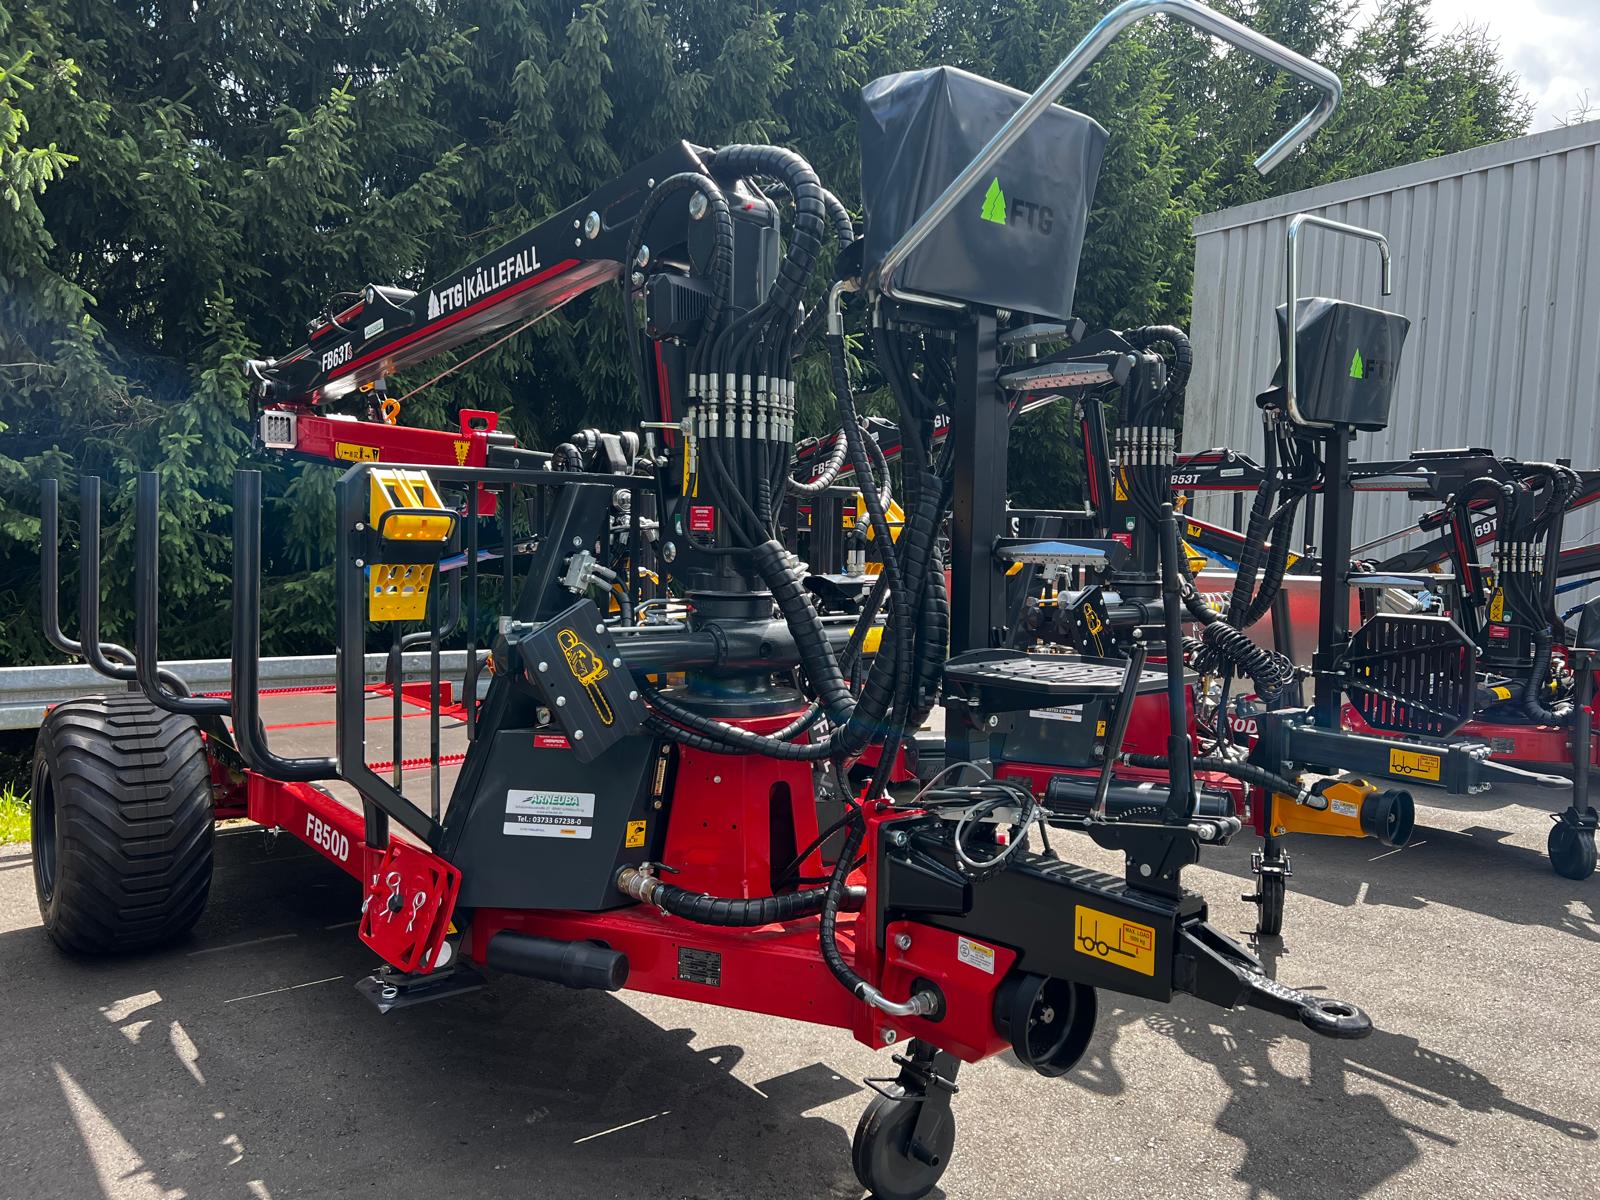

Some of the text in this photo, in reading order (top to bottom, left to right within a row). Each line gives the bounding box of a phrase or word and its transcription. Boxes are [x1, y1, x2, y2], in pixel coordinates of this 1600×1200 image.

[1010, 197, 1053, 236] FTG
[531, 793, 580, 807] ARNEUBA
[517, 815, 582, 825] Tel.: 03733 67238-0
[305, 812, 349, 862] FB50D
